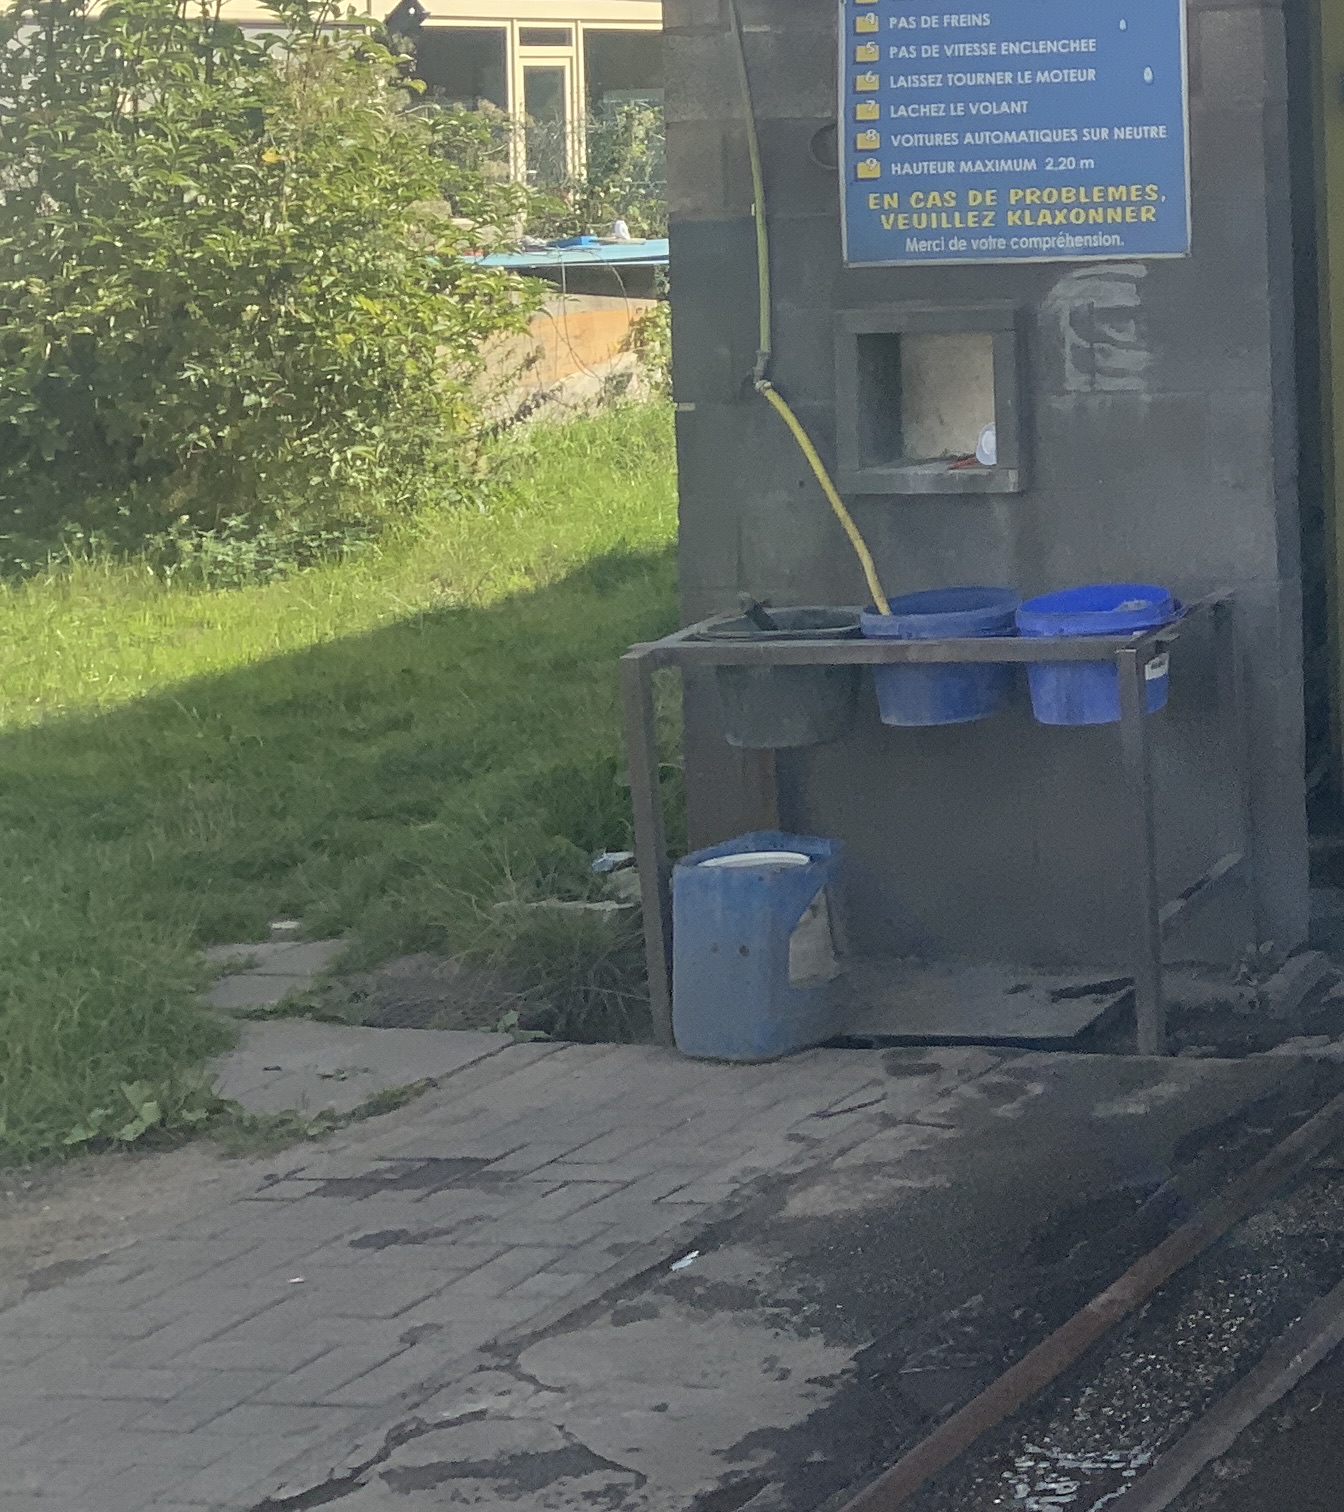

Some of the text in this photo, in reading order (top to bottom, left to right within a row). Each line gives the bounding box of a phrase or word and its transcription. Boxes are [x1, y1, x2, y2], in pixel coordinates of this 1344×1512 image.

[890, 13, 990, 29] PAS DE FREINS
[890, 39, 1096, 58] PAS DE VITESSE ENCLENCHEE
[891, 69, 1096, 89] LAISSEZ TOURNER LE MOTEUR
[891, 101, 1028, 118] LACHEZ LE VOLANT
[891, 126, 1167, 147] VOITURES AUTOMATIQUES SUR NEUTRE
[891, 159, 1094, 175] HAUTEUR MAXIMUM m
[868, 185, 1166, 210] EN CAS DE PROBLEMES,
[881, 206, 1157, 230] VEUILLEZ KLAXONNER
[906, 231, 1124, 253] Merci de votre compréhension.
